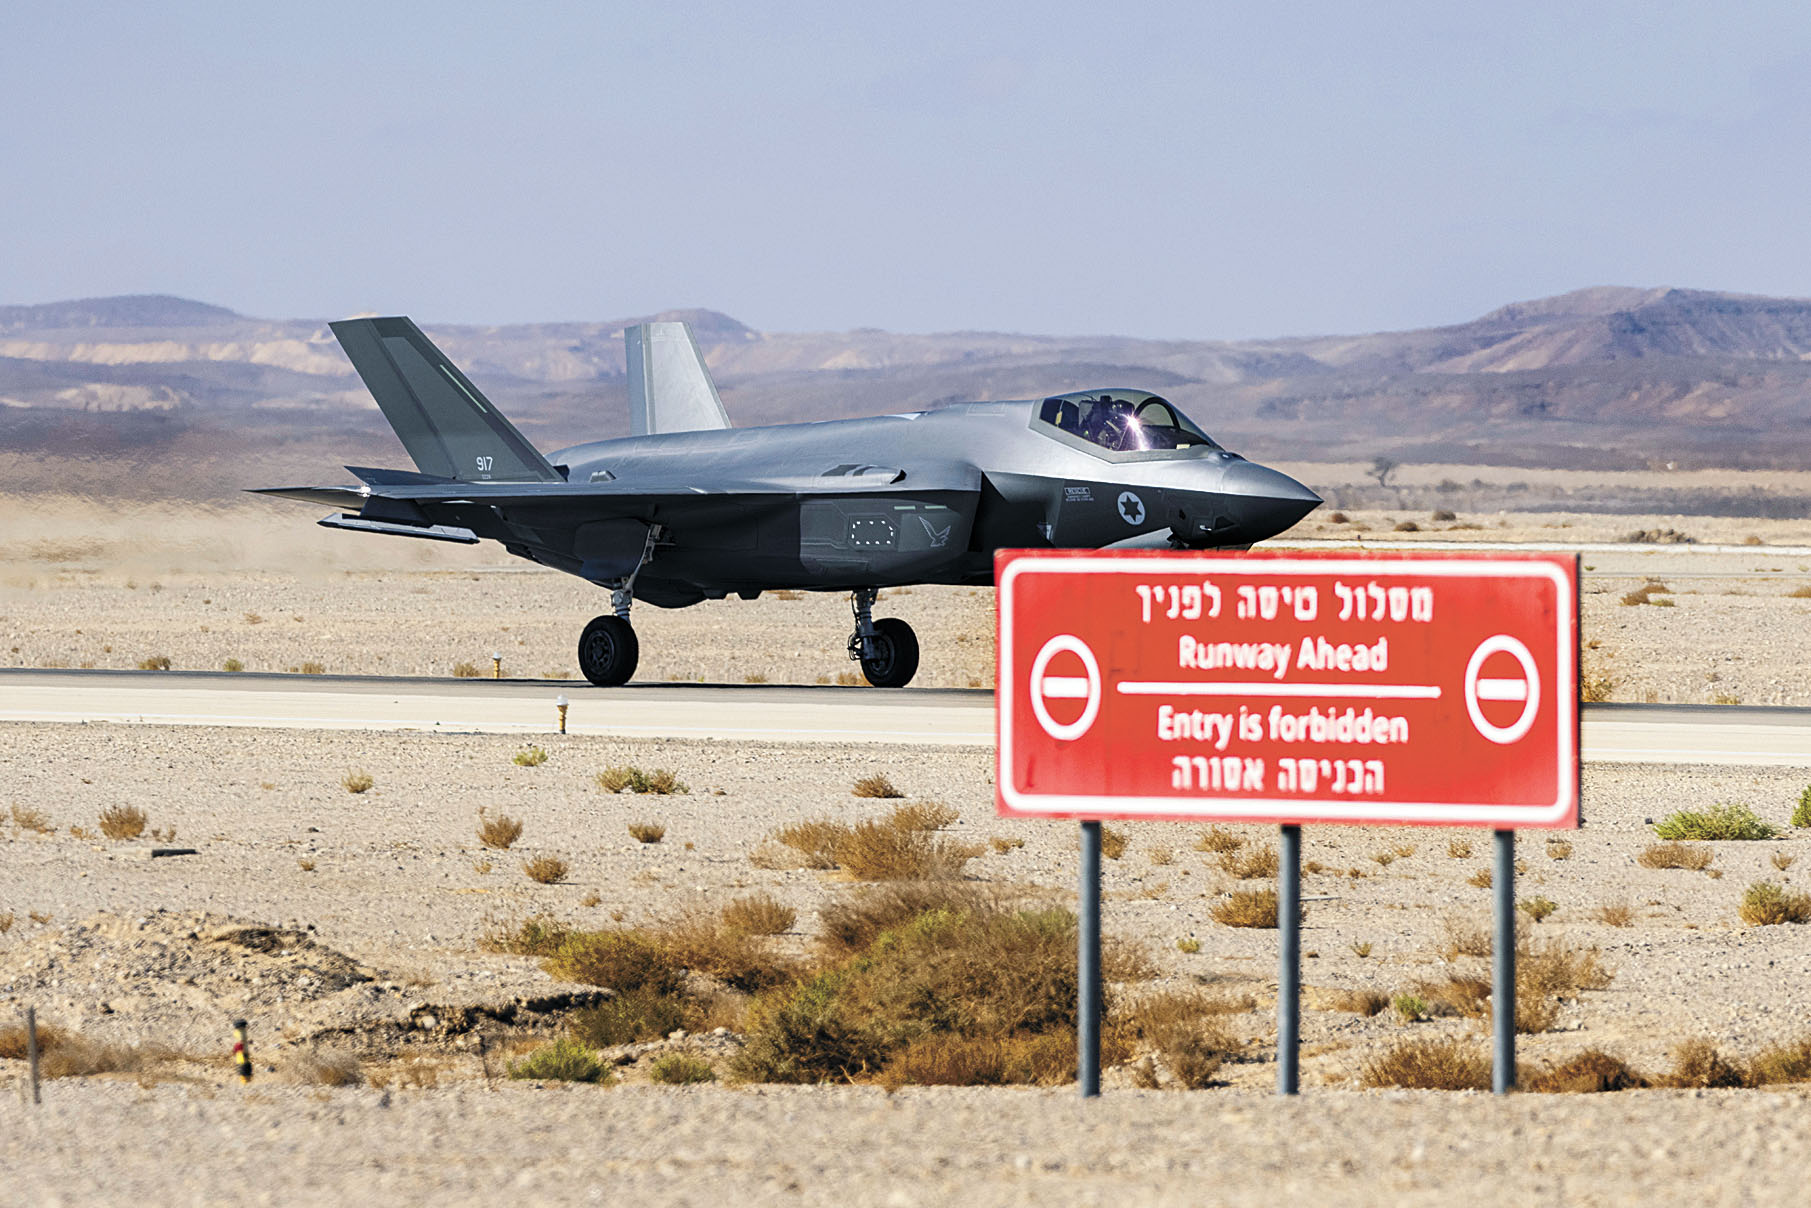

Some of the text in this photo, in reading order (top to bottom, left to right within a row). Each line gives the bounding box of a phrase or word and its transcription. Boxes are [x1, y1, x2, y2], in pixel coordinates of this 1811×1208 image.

[476, 456, 493, 471] 917
[1135, 580, 1433, 623] מסלול טיסה לפניך
[1179, 635, 1388, 680] Runway Ahead
[1158, 705, 1409, 750] Entry is forbidden
[1171, 755, 1385, 795] הכניסה אסורה
